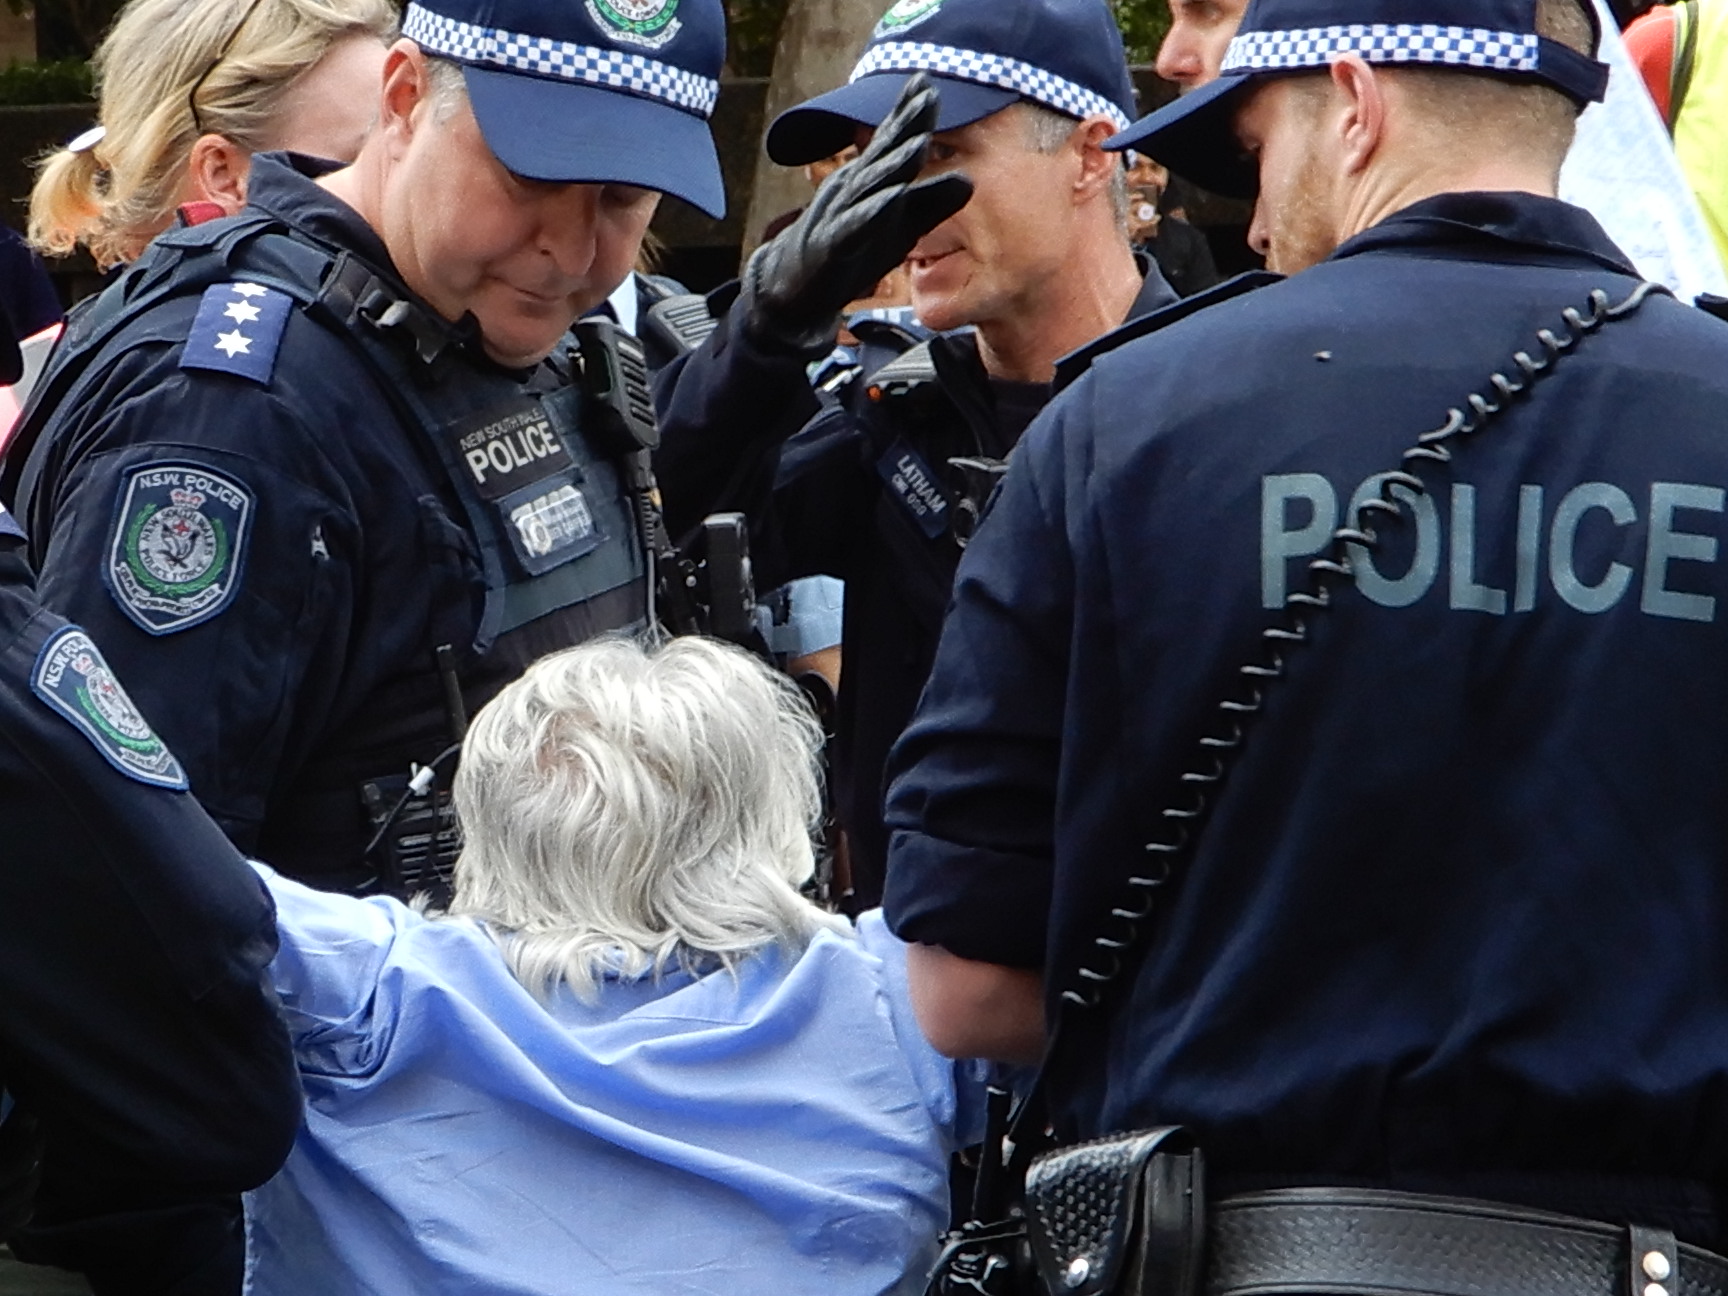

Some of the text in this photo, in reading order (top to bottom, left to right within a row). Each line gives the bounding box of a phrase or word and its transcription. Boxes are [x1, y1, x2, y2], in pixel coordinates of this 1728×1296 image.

[459, 430, 487, 451] NEW
[484, 417, 519, 439] SOUTH
[465, 421, 562, 484] POLICE
[184, 475, 242, 511] POLICE
[897, 454, 947, 513] LATHAM
[1262, 471, 1726, 623] POLICE
